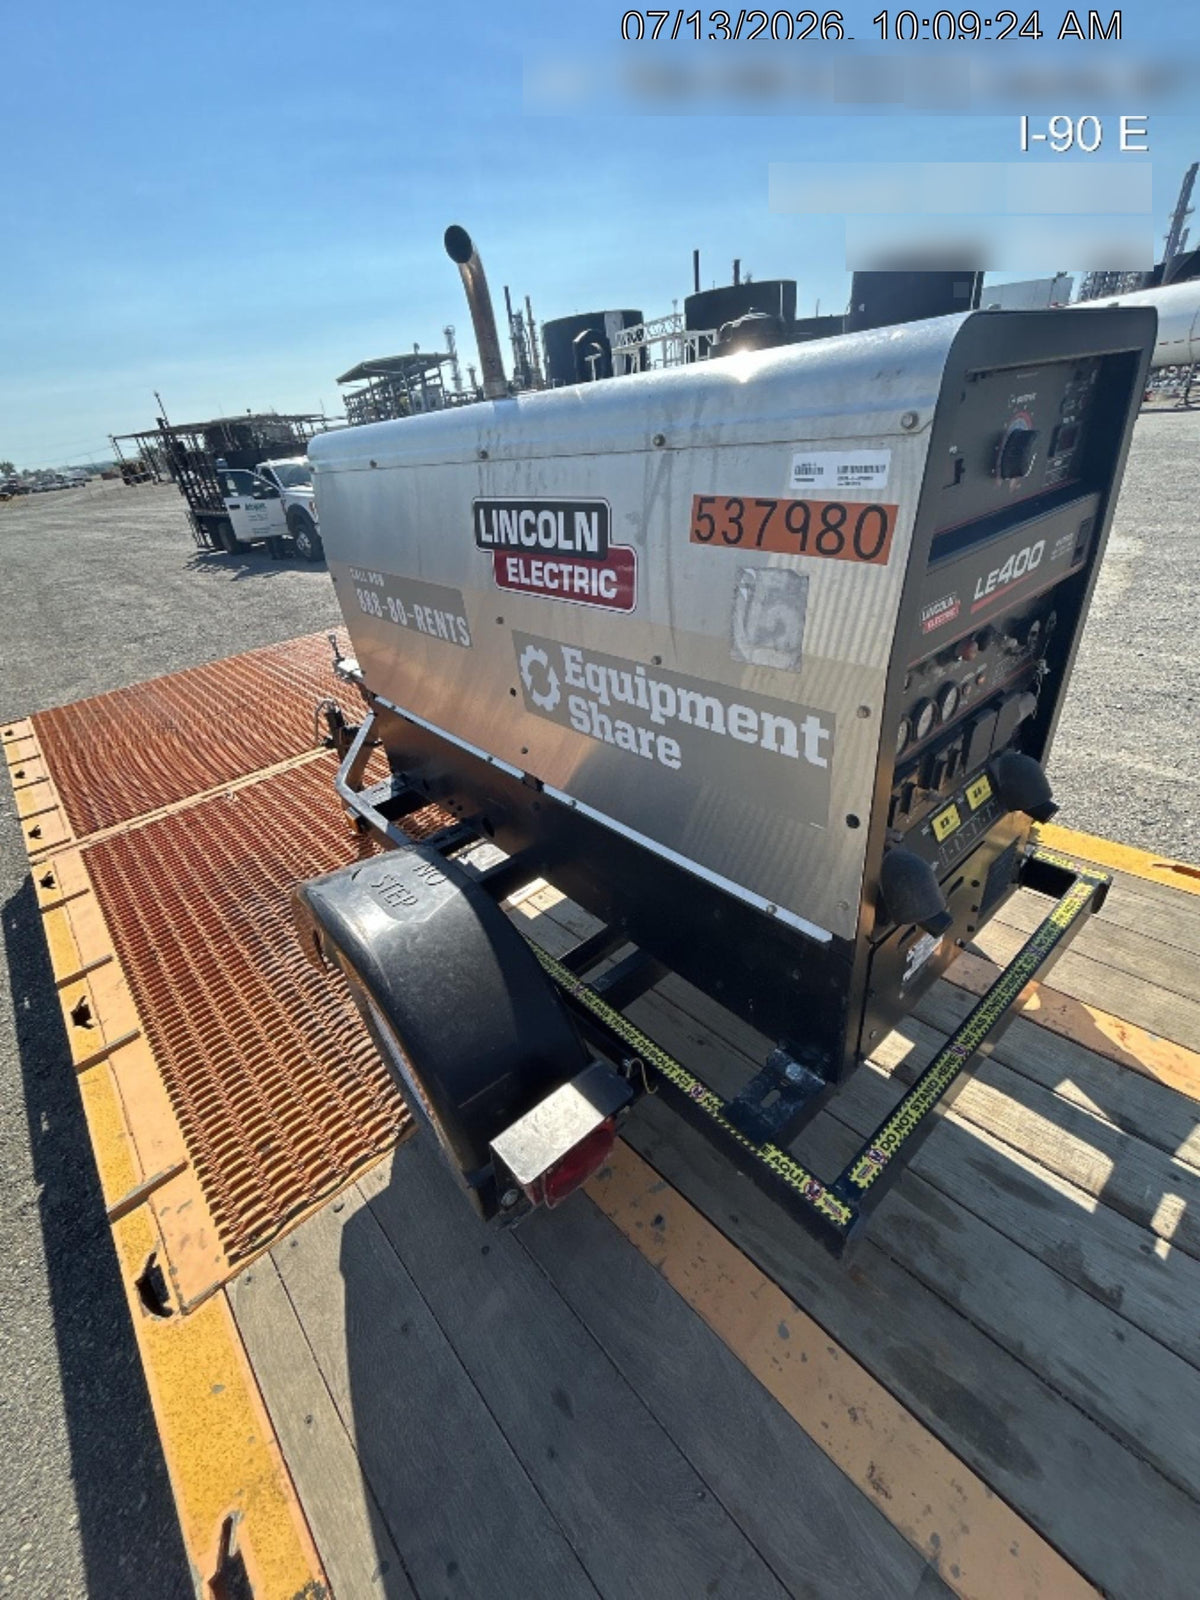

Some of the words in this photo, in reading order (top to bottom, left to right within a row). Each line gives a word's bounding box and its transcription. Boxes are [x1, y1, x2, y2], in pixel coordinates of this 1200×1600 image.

[479, 507, 599, 553] LINCOLN
[694, 496, 888, 561] 537980
[506, 556, 618, 599] ELECTRIC
[973, 539, 1046, 600] LE400
[559, 645, 830, 769] Equipment
[567, 694, 682, 770] Share
[369, 873, 419, 908] STEP
[412, 861, 447, 886] NO
[878, 1131, 898, 1152] DO
[892, 1109, 915, 1136] NOT
[909, 1076, 940, 1113] STAND
[769, 1152, 804, 1185] AQUI
